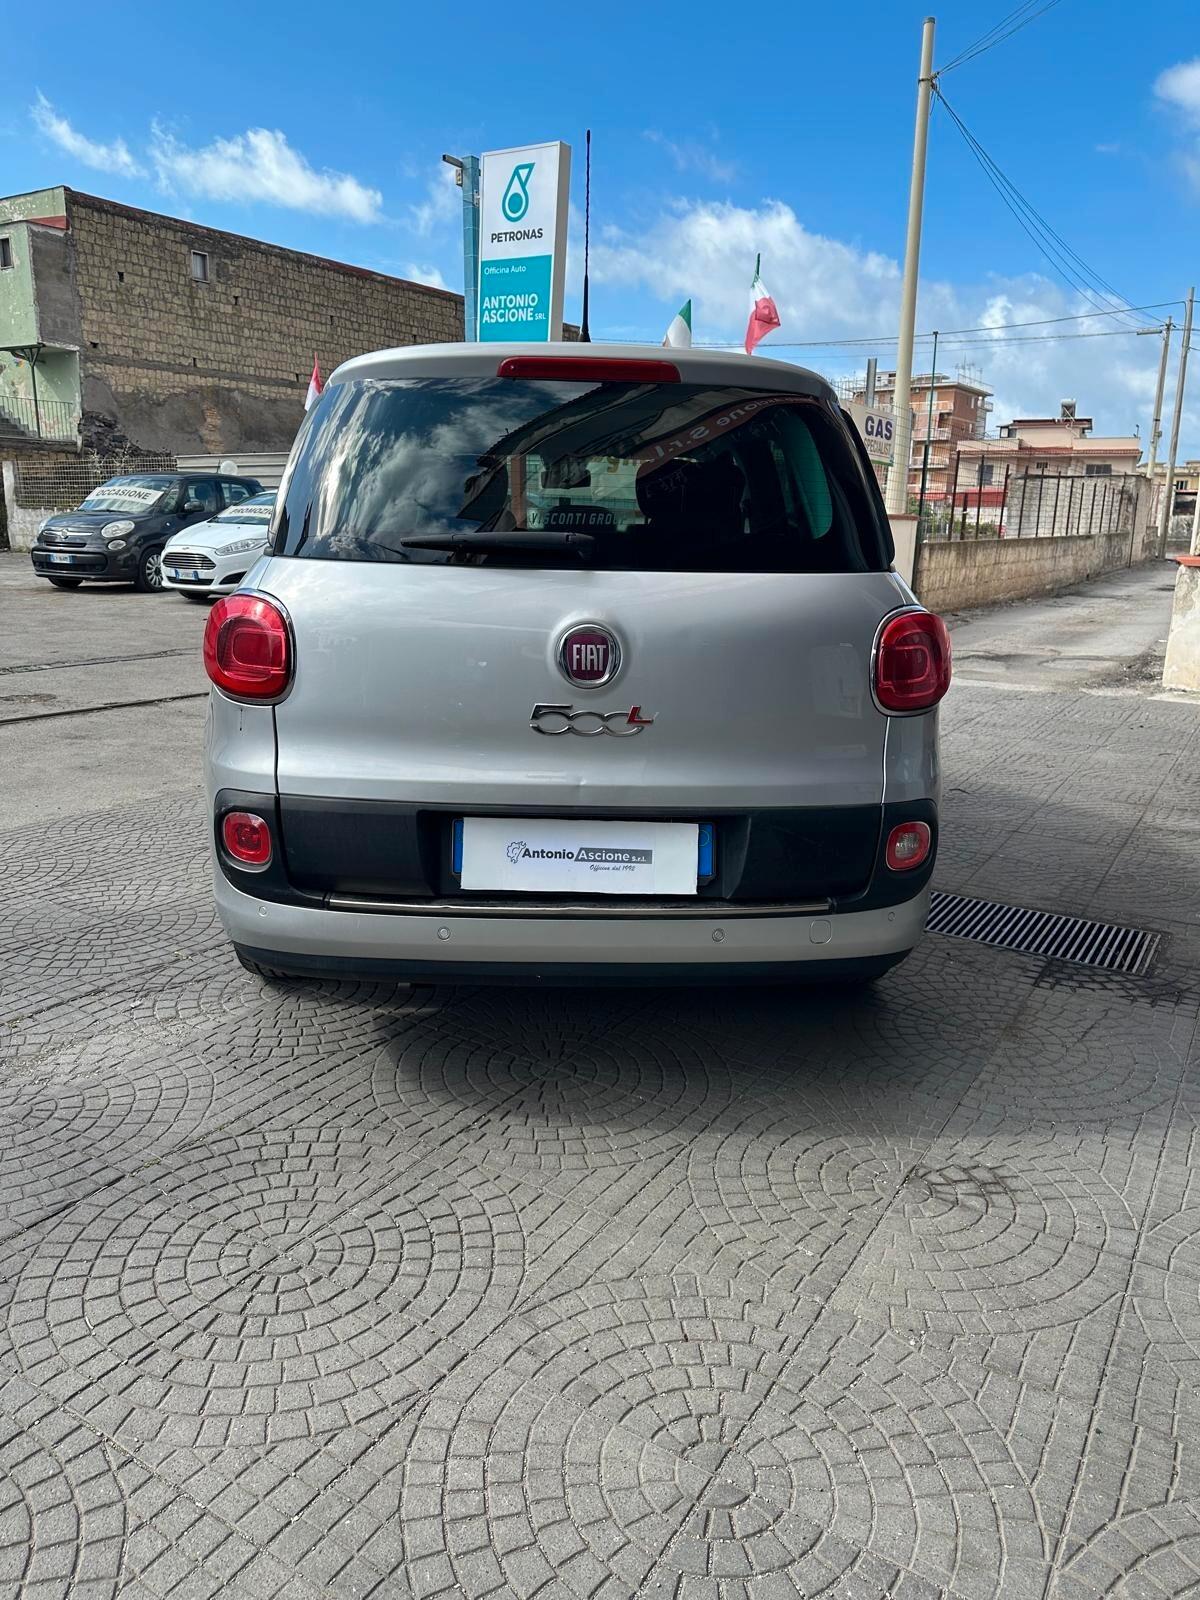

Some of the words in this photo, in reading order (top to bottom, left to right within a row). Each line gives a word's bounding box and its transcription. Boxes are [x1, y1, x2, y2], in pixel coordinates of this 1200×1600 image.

[490, 228, 543, 243] PETRONAS
[484, 266, 510, 275] Officina
[511, 265, 527, 274] Auto
[482, 293, 538, 309] ANTONIO
[482, 308, 534, 324] ASCIONE
[535, 313, 546, 321] SRL
[864, 415, 893, 441] GAS
[95, 488, 152, 501] OCCASIONE
[572, 644, 607, 671] FIAT
[529, 703, 655, 737] 500L
[522, 848, 575, 860] Antonio
[578, 849, 630, 862] Ascione
